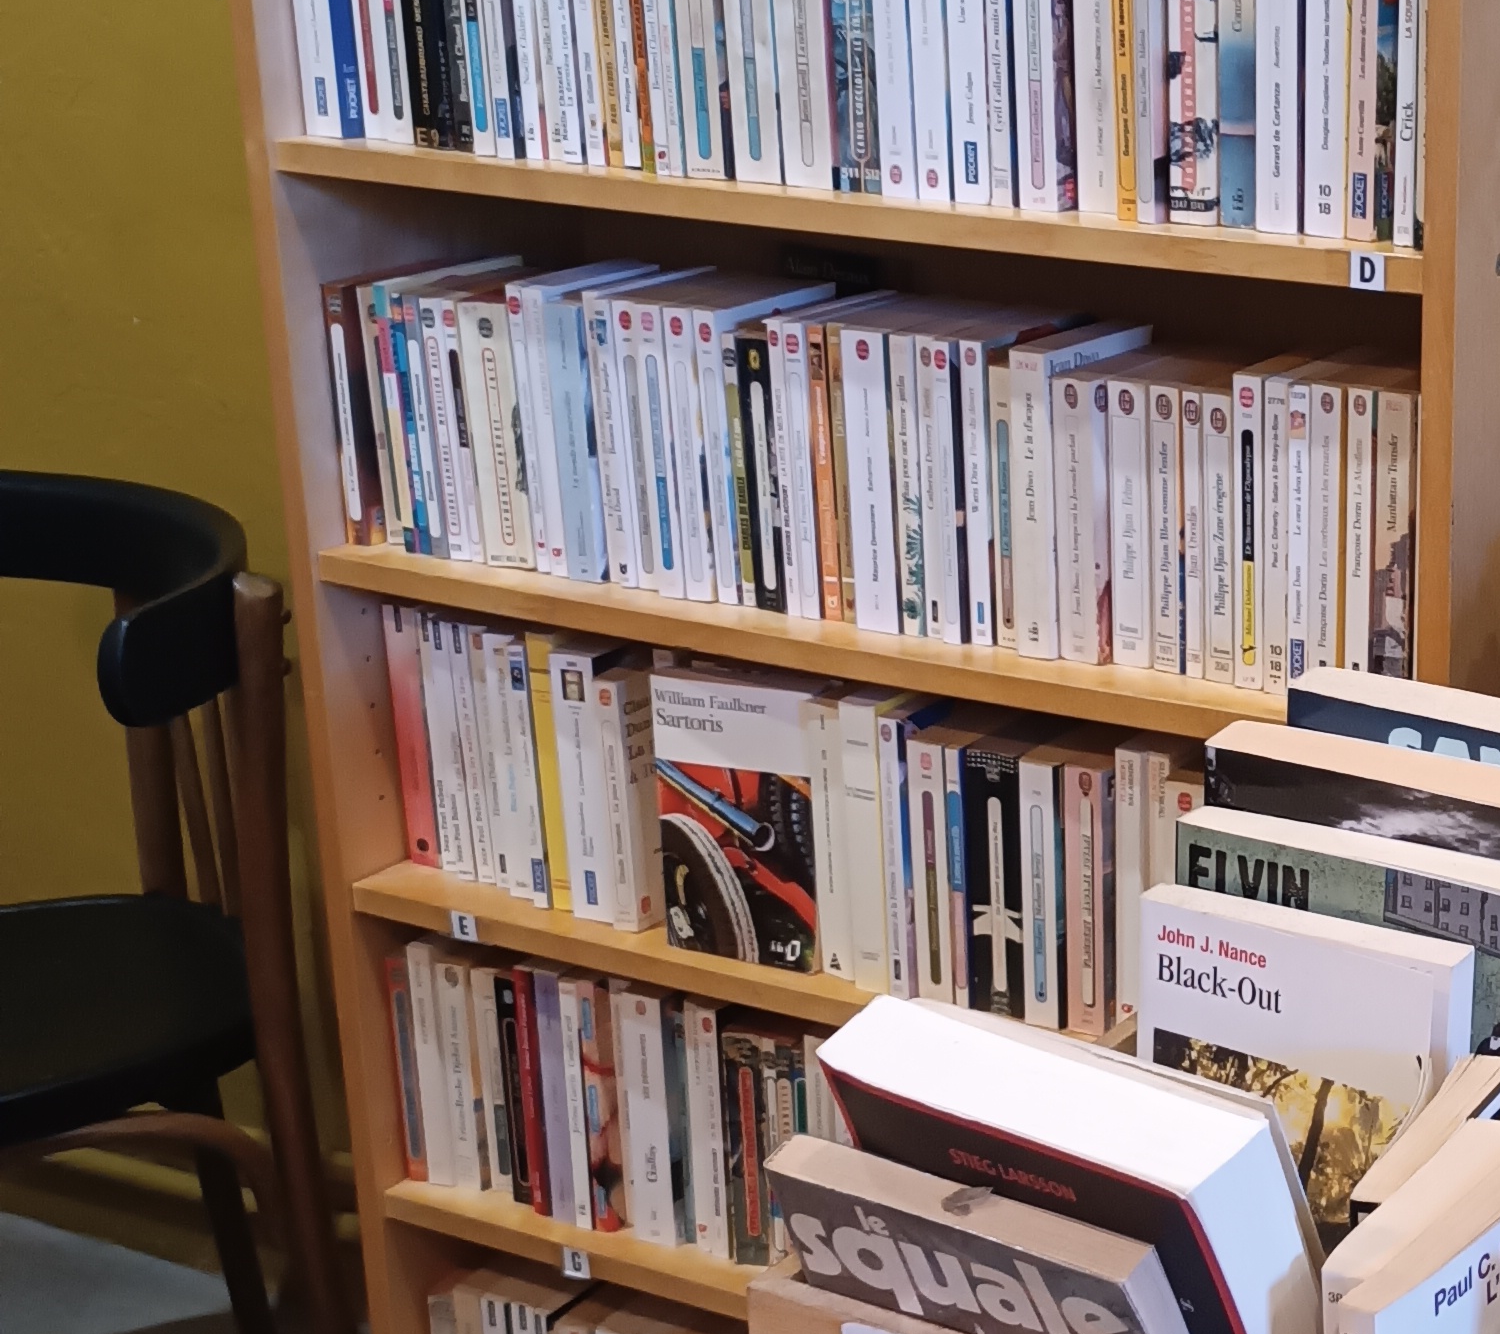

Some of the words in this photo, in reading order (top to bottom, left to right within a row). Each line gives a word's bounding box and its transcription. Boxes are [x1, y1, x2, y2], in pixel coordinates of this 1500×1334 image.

[1400, 101, 1415, 143] Crick
[1359, 257, 1376, 283] D
[1386, 434, 1400, 474] Transfer
[1387, 477, 1399, 532] Manhattan
[1214, 575, 1227, 617] Philippe
[654, 688, 705, 709] William
[709, 695, 768, 715] Faulkner
[656, 707, 724, 733] Sartoris
[1187, 842, 1310, 912] ELVIN
[457, 916, 470, 936] E
[1157, 924, 1196, 951] John
[1199, 932, 1214, 956] J.
[1217, 939, 1267, 969] Nance
[1156, 952, 1283, 1015] Black-Out
[948, 1148, 998, 1177] STIEG
[998, 1163, 1078, 1202] LARSSON
[854, 1205, 888, 1237] le
[1433, 1273, 1473, 1317] Paul
[1477, 1253, 1498, 1282] C.
